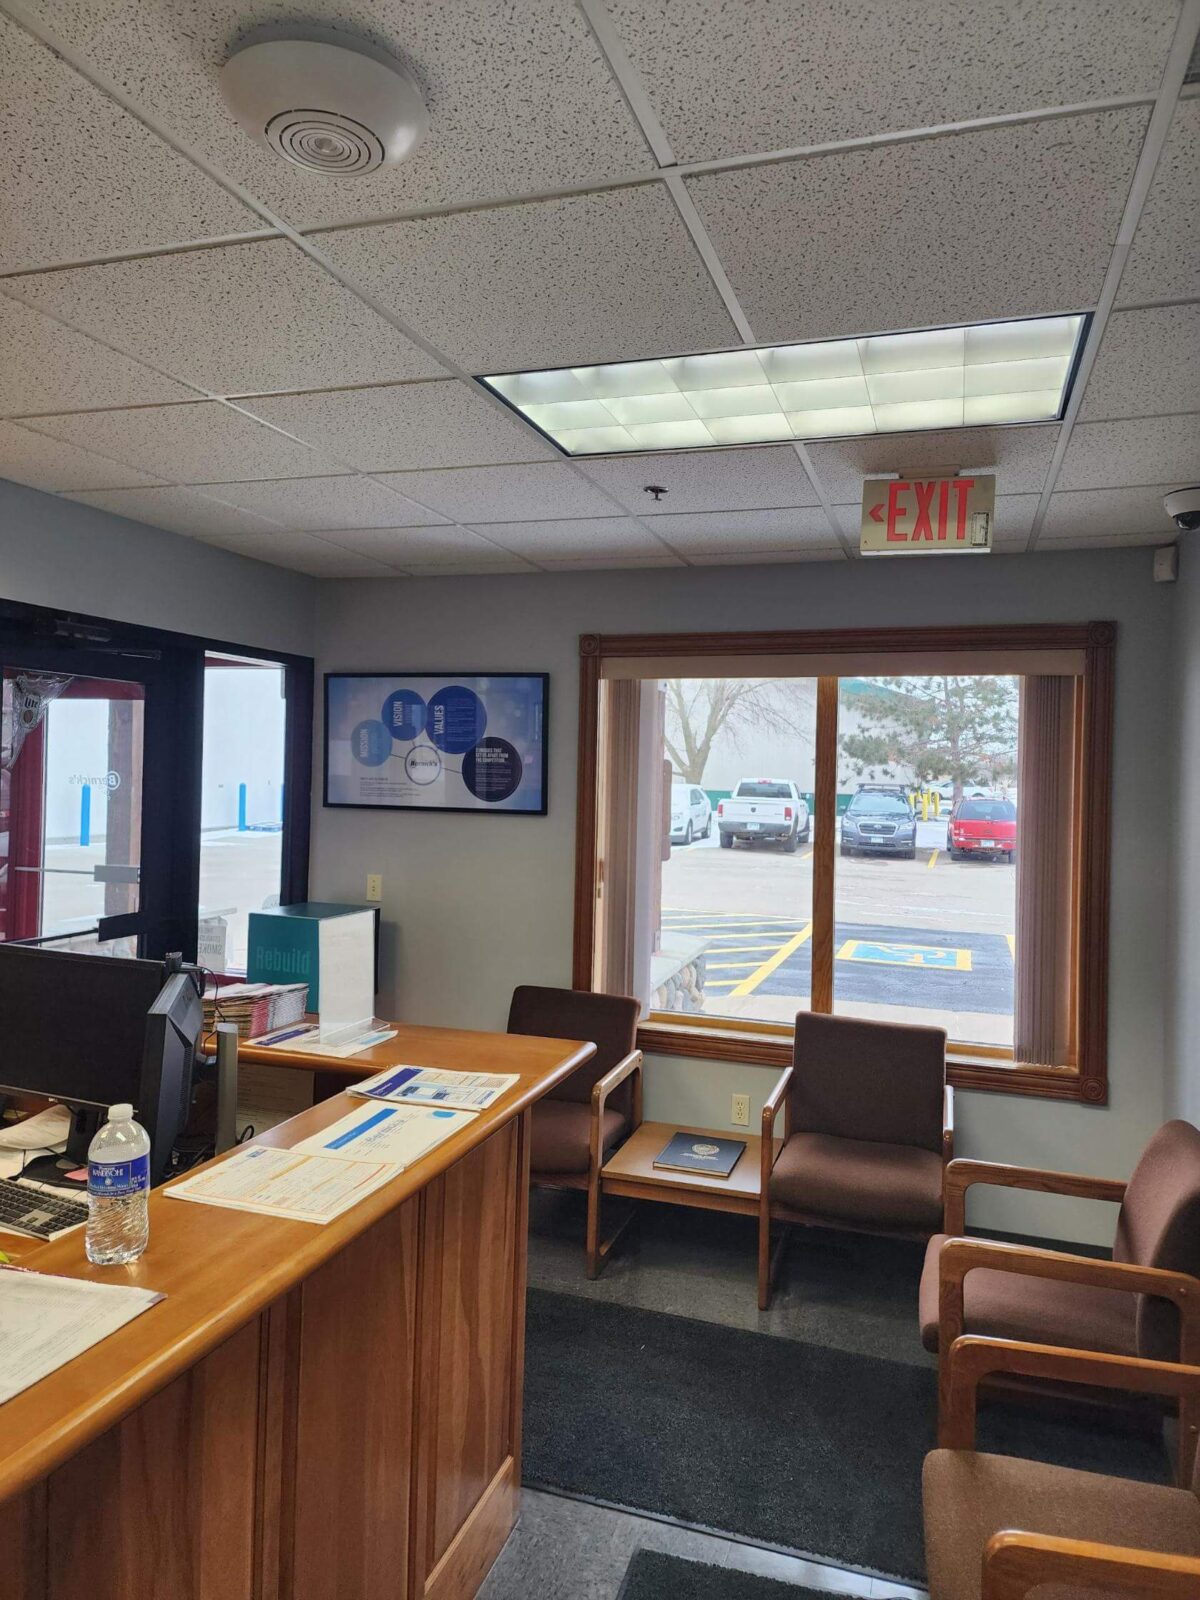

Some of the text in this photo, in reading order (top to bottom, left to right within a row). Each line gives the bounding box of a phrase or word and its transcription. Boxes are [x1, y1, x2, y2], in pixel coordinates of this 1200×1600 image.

[887, 480, 974, 541] EXIT
[393, 701, 403, 726] VISION
[434, 704, 445, 735] VALUES
[359, 728, 369, 758] MISSION
[254, 946, 311, 975] Rebuild
